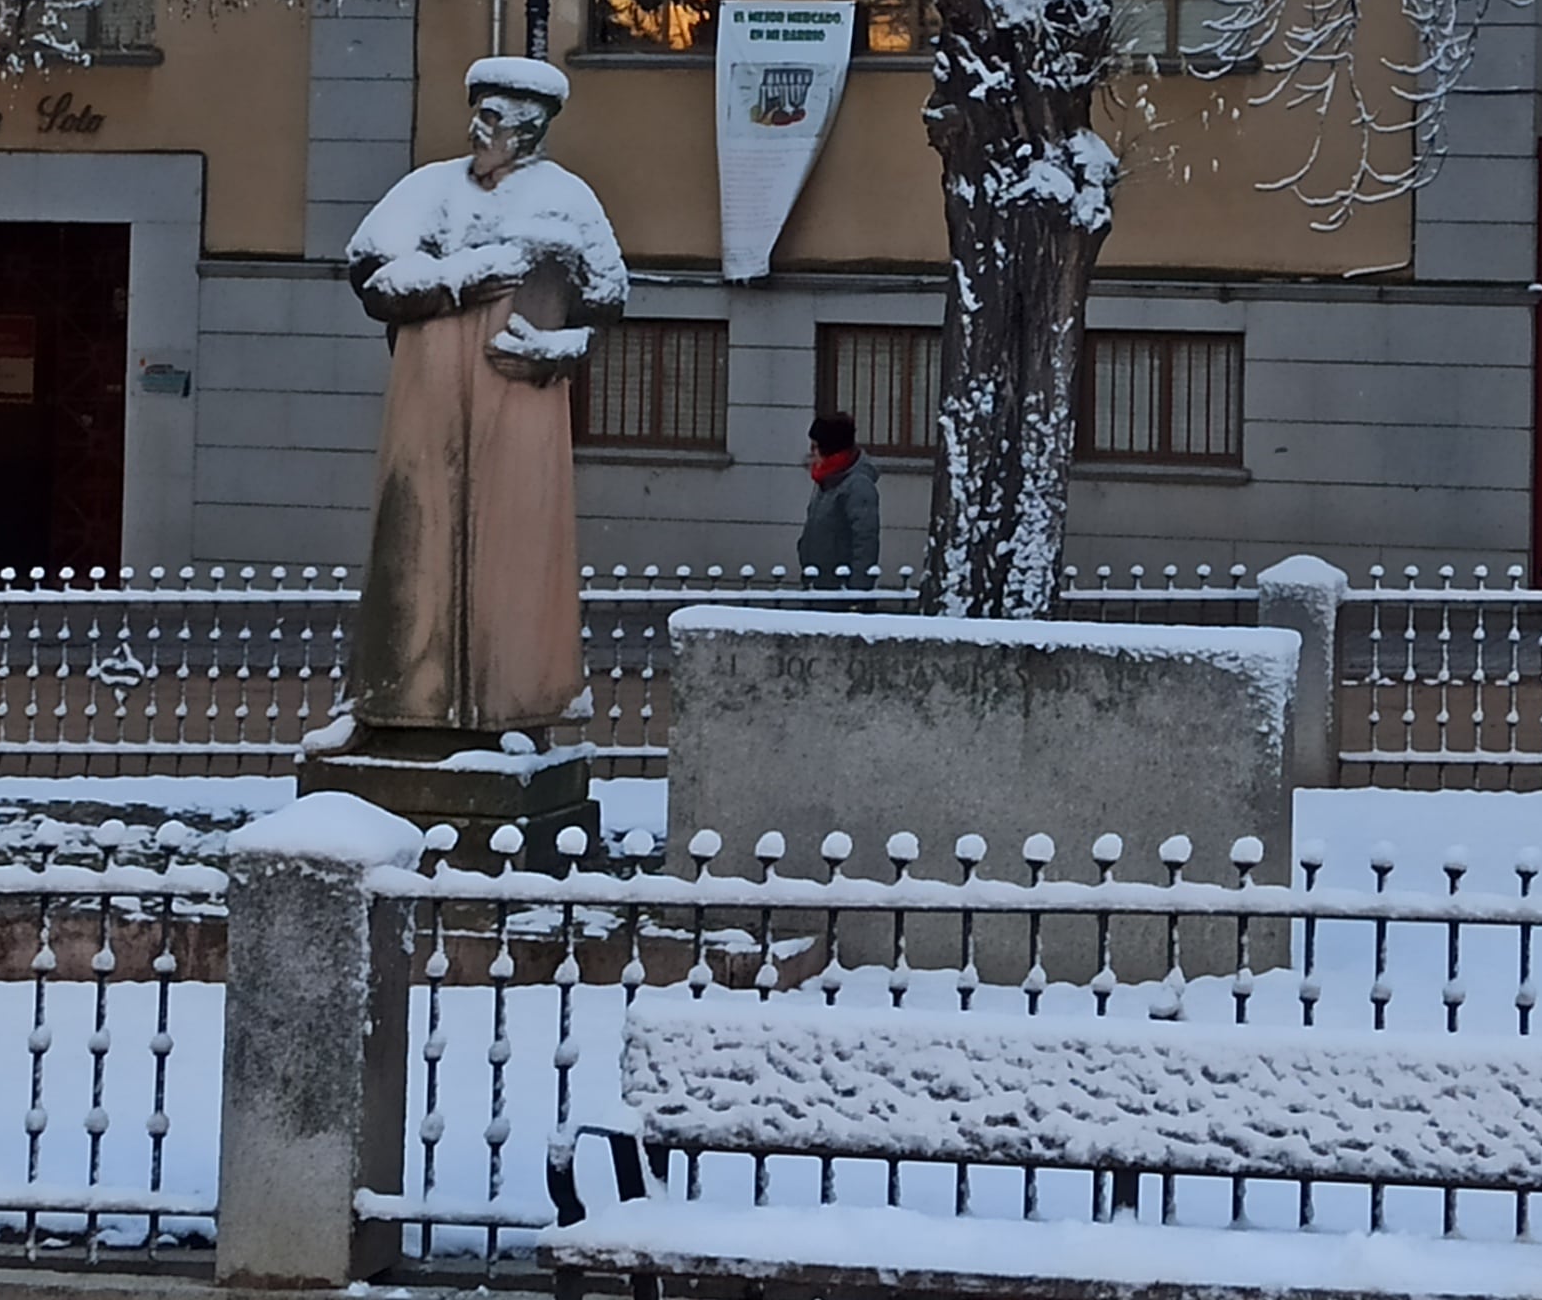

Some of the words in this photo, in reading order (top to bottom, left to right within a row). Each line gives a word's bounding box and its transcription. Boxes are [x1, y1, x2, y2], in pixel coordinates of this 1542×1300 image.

[733, 11, 745, 23] EL
[747, 11, 785, 23] MEJOR
[749, 29, 764, 41] EN
[765, 29, 781, 41] MI
[782, 29, 826, 42] BARRIO
[36, 92, 106, 133] Soto
